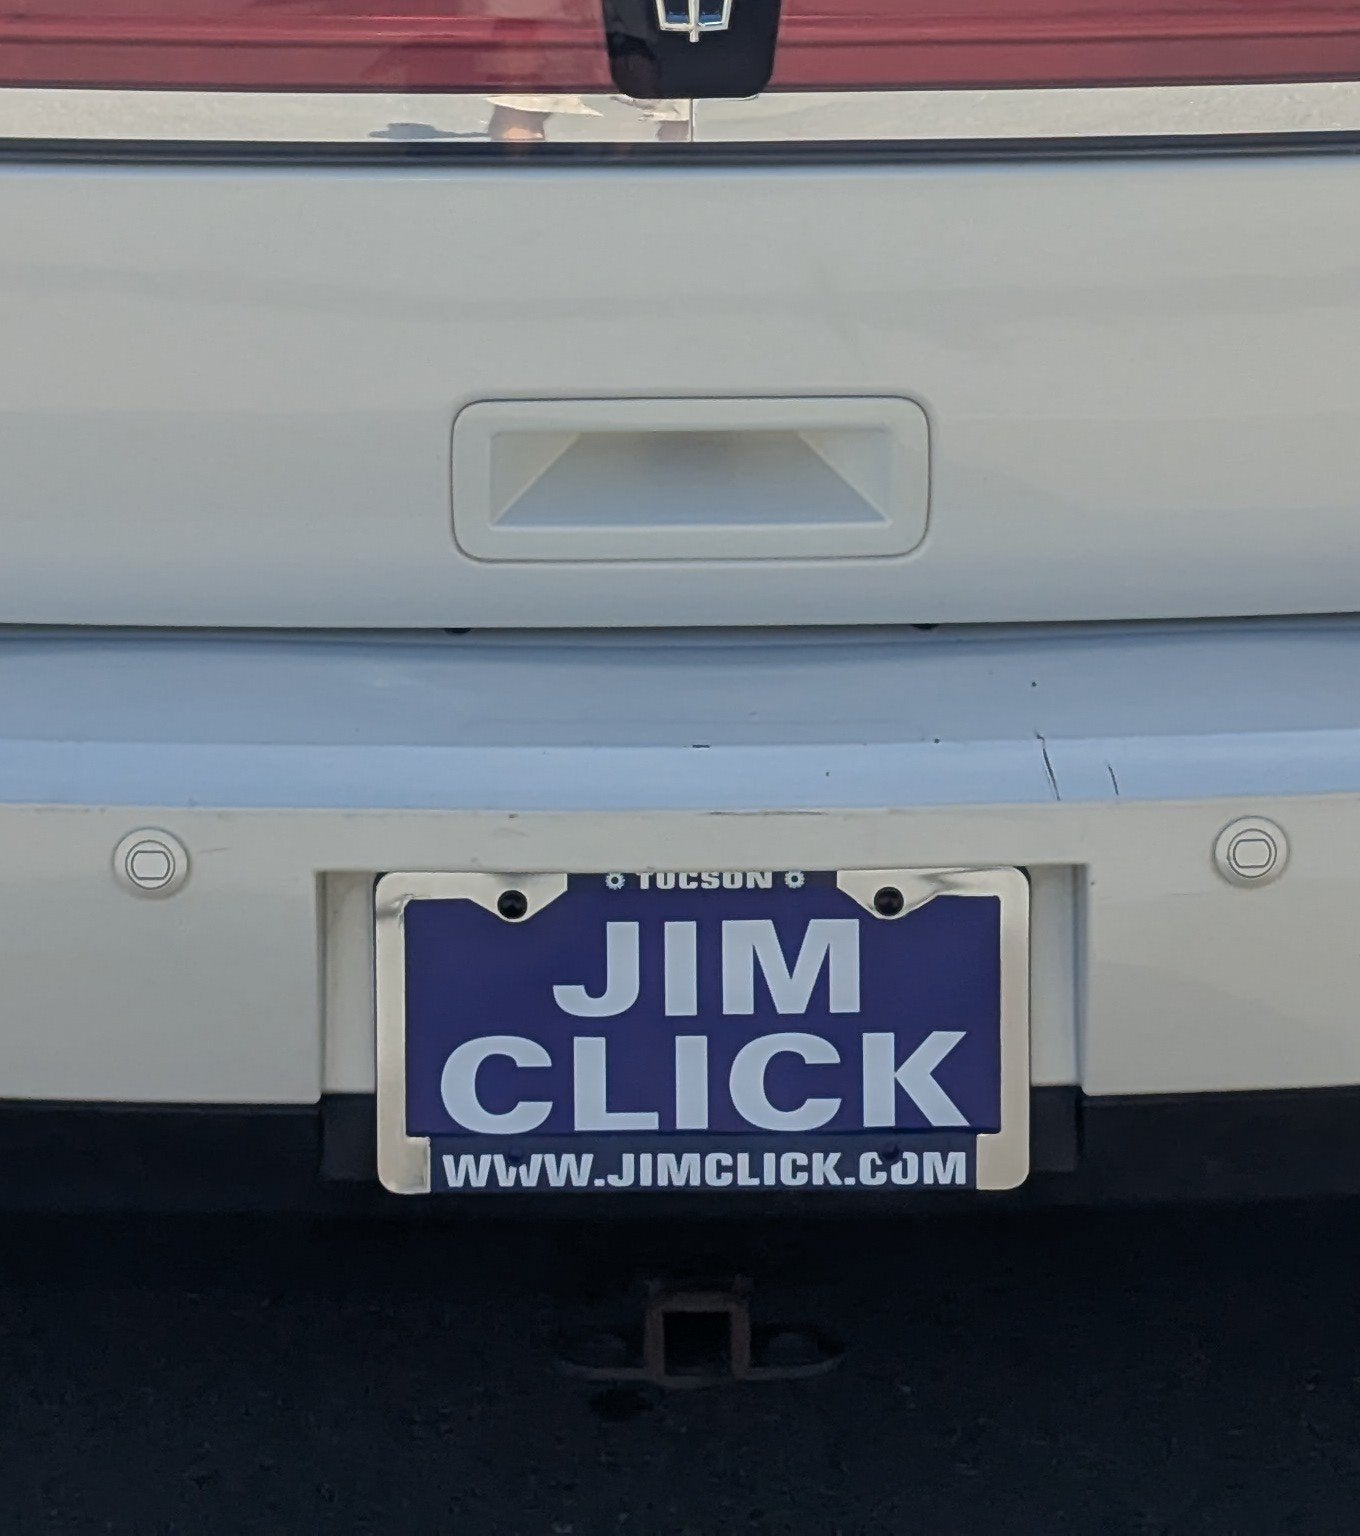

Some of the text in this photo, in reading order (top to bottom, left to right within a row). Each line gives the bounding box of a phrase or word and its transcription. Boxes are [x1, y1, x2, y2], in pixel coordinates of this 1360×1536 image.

[636, 871, 773, 890] TUCSON
[552, 918, 861, 1017] JIM
[440, 1030, 971, 1135] CLICK
[442, 1151, 968, 1188] WWW.JIMCLICK.COM
